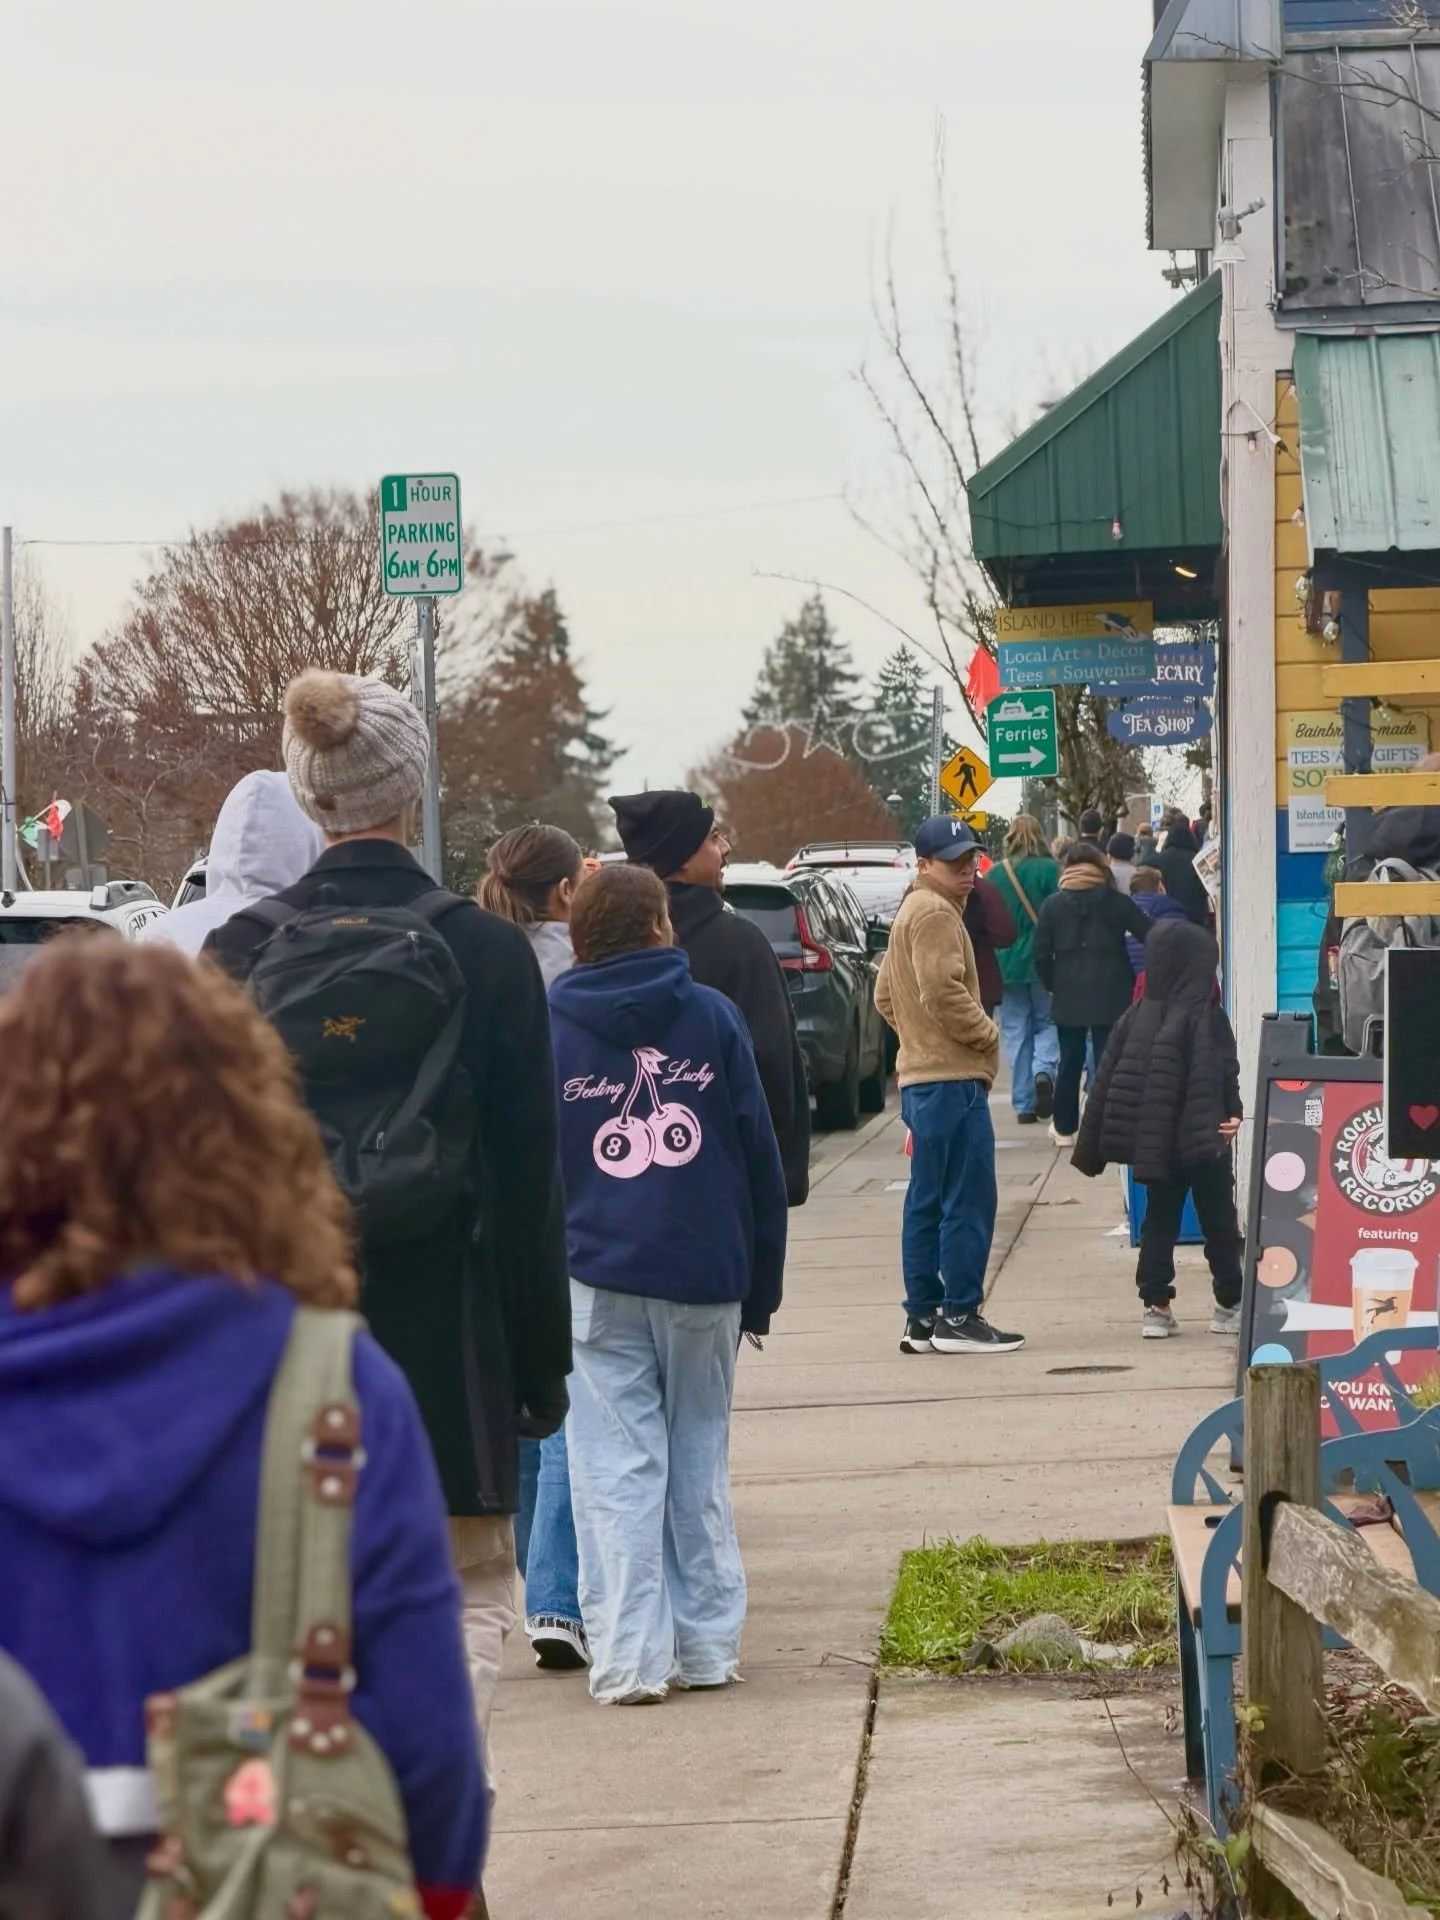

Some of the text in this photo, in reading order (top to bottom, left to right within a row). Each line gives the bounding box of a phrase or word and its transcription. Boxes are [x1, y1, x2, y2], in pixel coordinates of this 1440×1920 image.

[391, 481, 452, 508] 1 HOUR
[388, 522, 455, 544] PARKING
[387, 550, 420, 579] 6AM
[426, 549, 458, 577] 6PM
[1000, 611, 1098, 632] ISLAND LIFE
[1005, 646, 1047, 664] Local
[1052, 647, 1080, 662] Art
[1005, 663, 1146, 683] Tees Souvenirs
[1151, 665, 1204, 686] ECARY
[995, 726, 1049, 743] Ferries
[1295, 721, 1344, 739] Bainbr
[1291, 750, 1330, 765] TEES
[1374, 747, 1419, 762] GIFTS
[1296, 809, 1343, 820] Island Life
[563, 1059, 714, 1104] Feeling Lucky
[671, 1127, 686, 1148] 8
[1336, 1106, 1384, 1153] ROCKI
[606, 1137, 622, 1157] 8
[1340, 1176, 1436, 1213] RECORDS
[1358, 1228, 1419, 1242] featuring
[1327, 1381, 1422, 1396] YOU KNW
